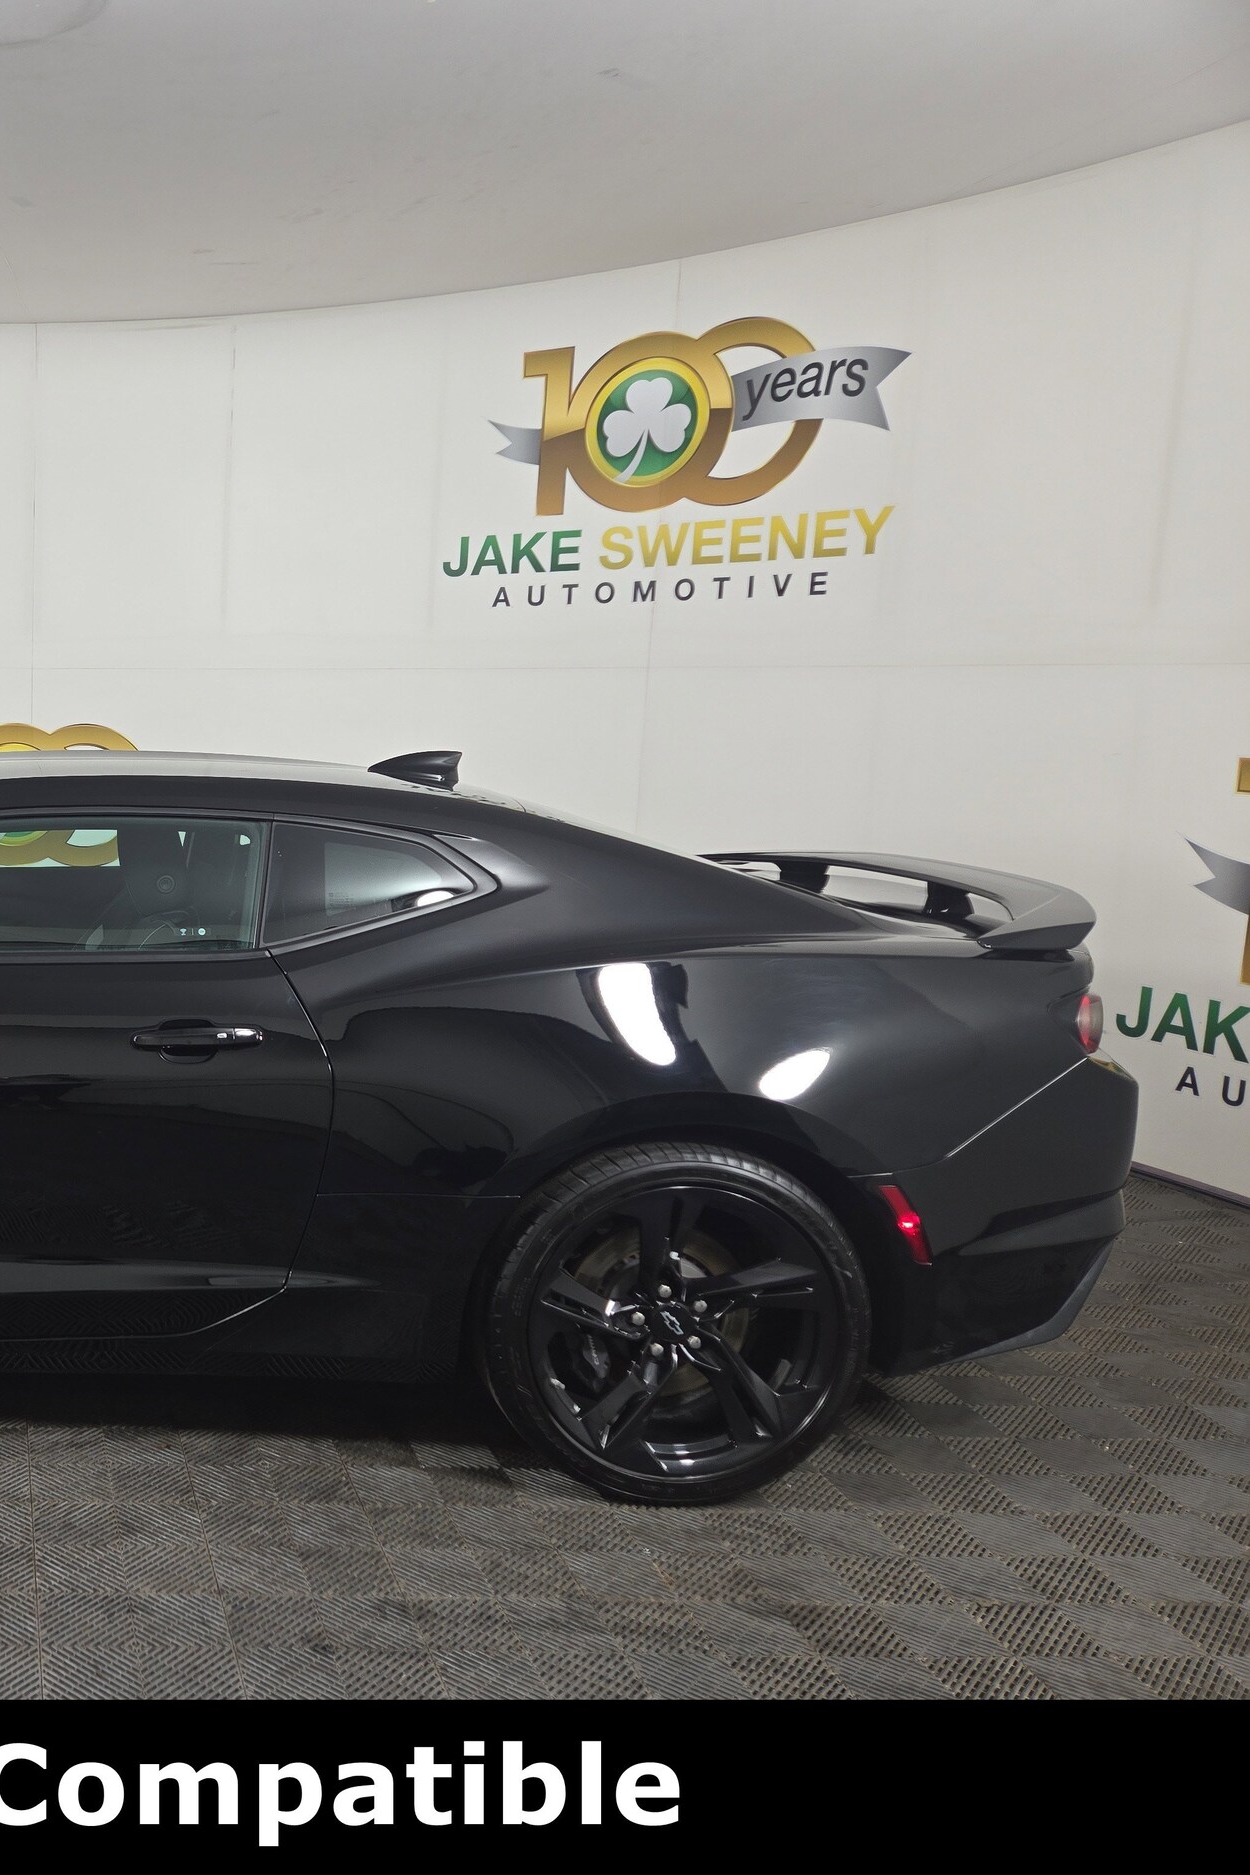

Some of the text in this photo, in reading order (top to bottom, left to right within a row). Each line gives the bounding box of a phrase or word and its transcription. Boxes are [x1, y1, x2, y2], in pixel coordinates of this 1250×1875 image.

[524, 316, 868, 516] 100 years
[443, 505, 895, 577] JAKE SWEENEY
[492, 571, 828, 607] AUTOMOTIVE
